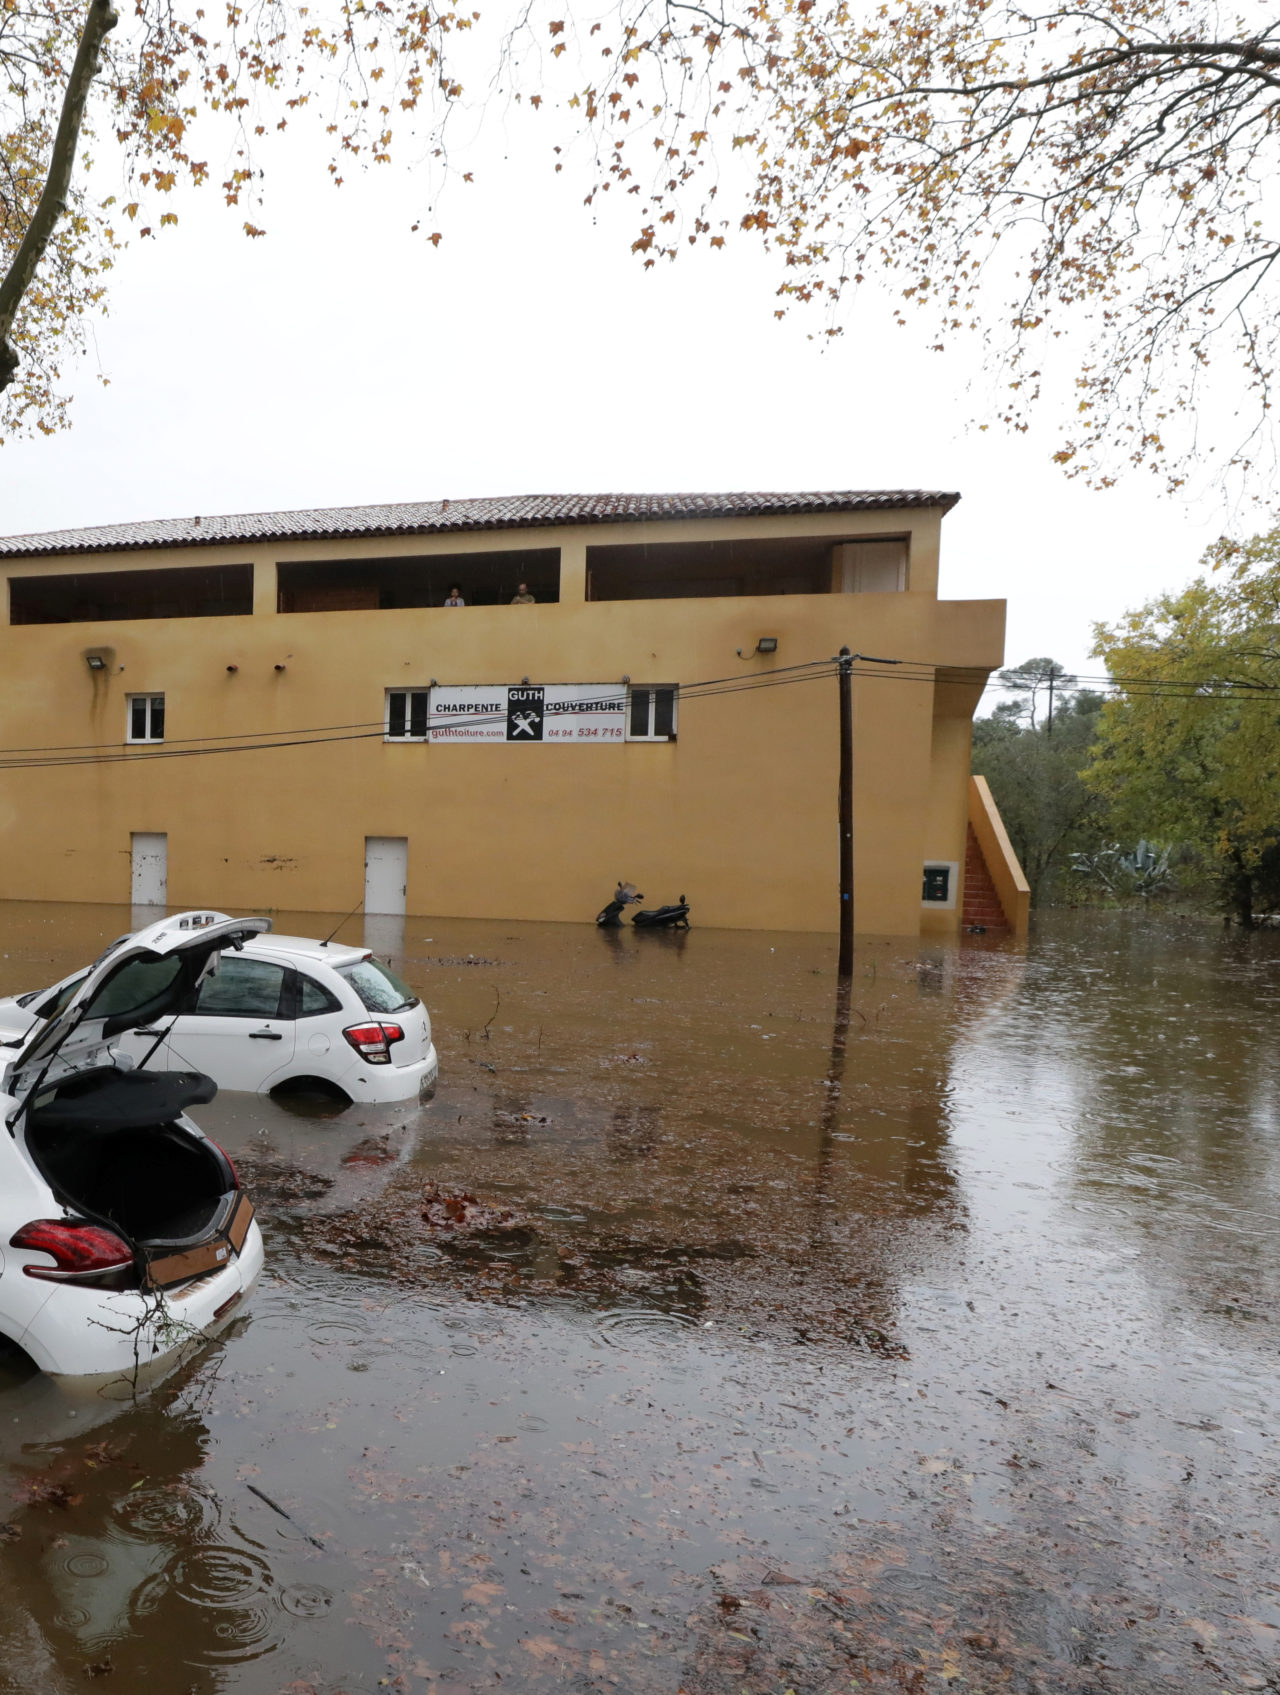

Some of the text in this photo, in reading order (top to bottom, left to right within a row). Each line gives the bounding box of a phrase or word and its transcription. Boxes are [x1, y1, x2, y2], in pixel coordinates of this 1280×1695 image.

[509, 690, 543, 700] GUTH
[436, 703, 502, 712] CHARPENTE
[545, 702, 624, 711] COUVERTURE
[431, 728, 504, 739] guthtoiture.com
[577, 728, 598, 736] 534
[601, 728, 622, 736] 715
